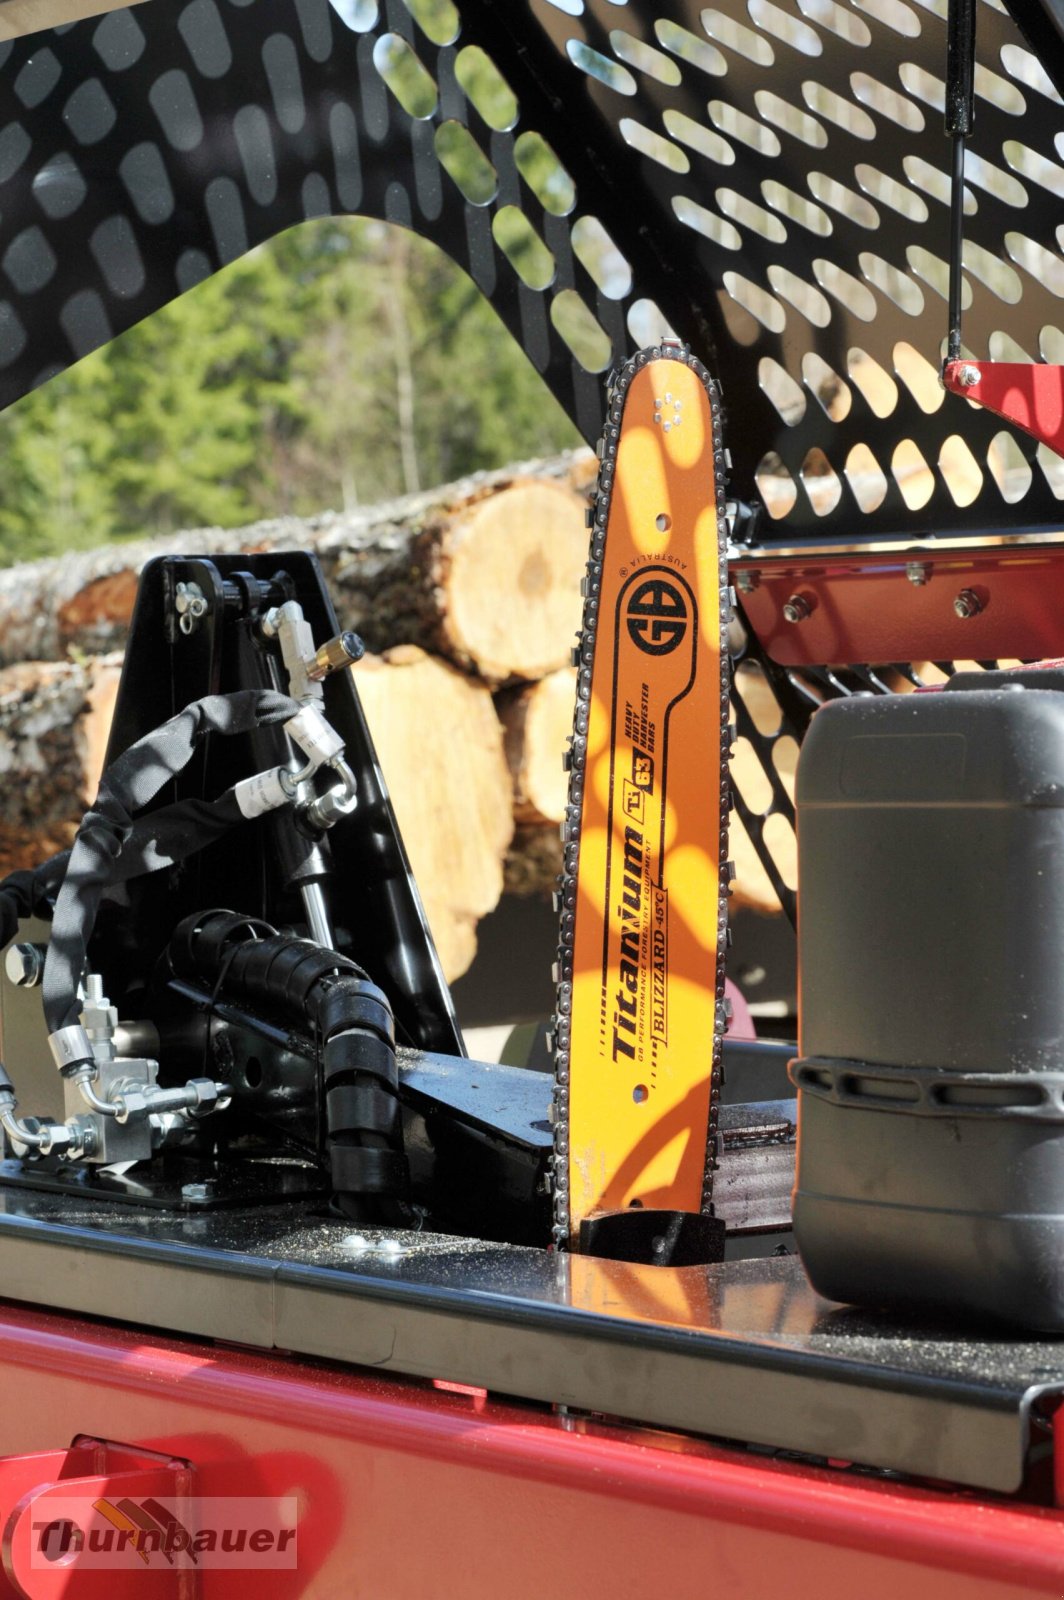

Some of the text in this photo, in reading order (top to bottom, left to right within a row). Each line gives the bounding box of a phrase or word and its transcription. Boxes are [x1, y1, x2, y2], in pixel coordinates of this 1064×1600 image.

[630, 553, 688, 569] AUSTRALIA
[627, 580, 687, 656] GB
[624, 700, 633, 739] HEAVY
[632, 711, 641, 743] DUTY
[639, 682, 650, 749] HARVESTER
[647, 721, 656, 754] BARS
[635, 757, 651, 786] 63
[627, 791, 641, 813] Ti
[612, 825, 644, 1063] Titanium
[637, 839, 652, 1062] GB PERFORMANCE FORESTRY EQUIPMENT
[653, 931, 665, 1035] BLIZZARD
